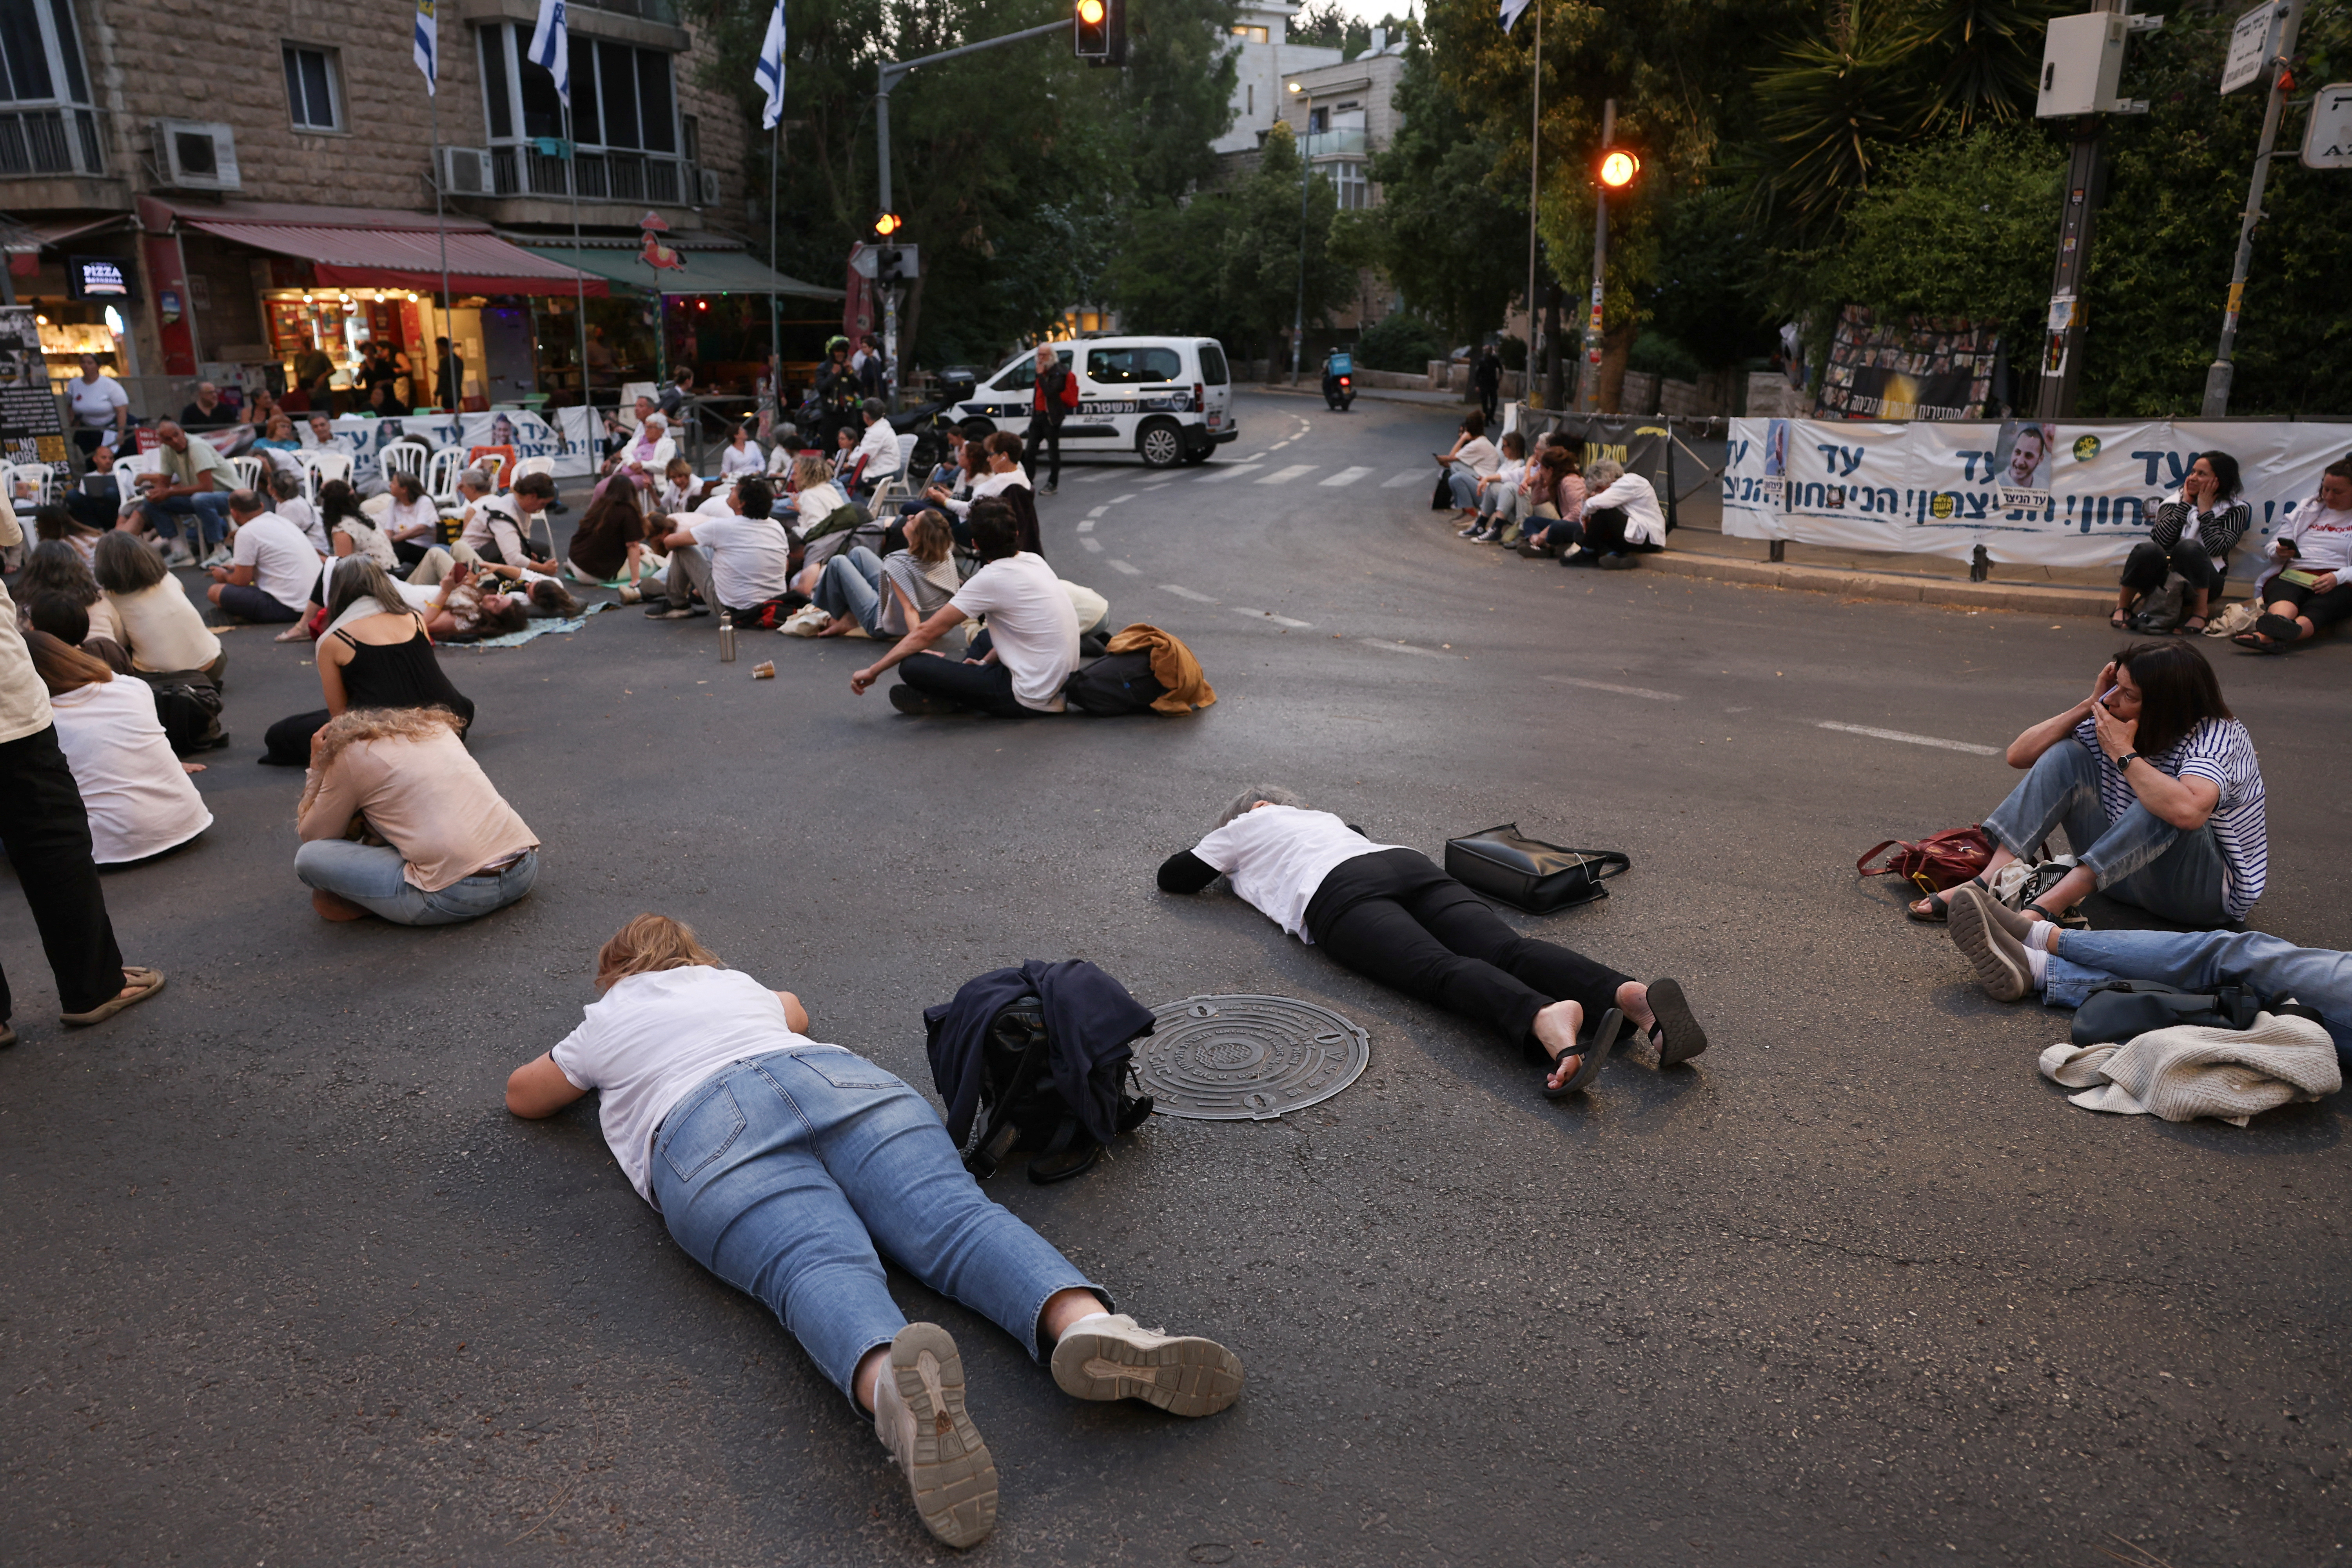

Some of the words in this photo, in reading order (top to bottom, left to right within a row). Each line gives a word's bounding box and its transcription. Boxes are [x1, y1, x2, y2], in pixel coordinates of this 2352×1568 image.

[83, 265, 122, 277] PIZZA
[1082, 402, 1134, 414] משטרת
[19, 436, 37, 451] NO
[5, 451, 40, 464] MORE
[1818, 444, 1864, 477] עד
[2033, 495, 2046, 505] עד
[1180, 1033, 1212, 1049] חברת
[1149, 1054, 1172, 1076] ביוב
[1175, 1050, 1194, 1070] הגיחון
[1192, 1069, 1228, 1080] בע"מ
[1286, 1088, 1304, 1096] SII
